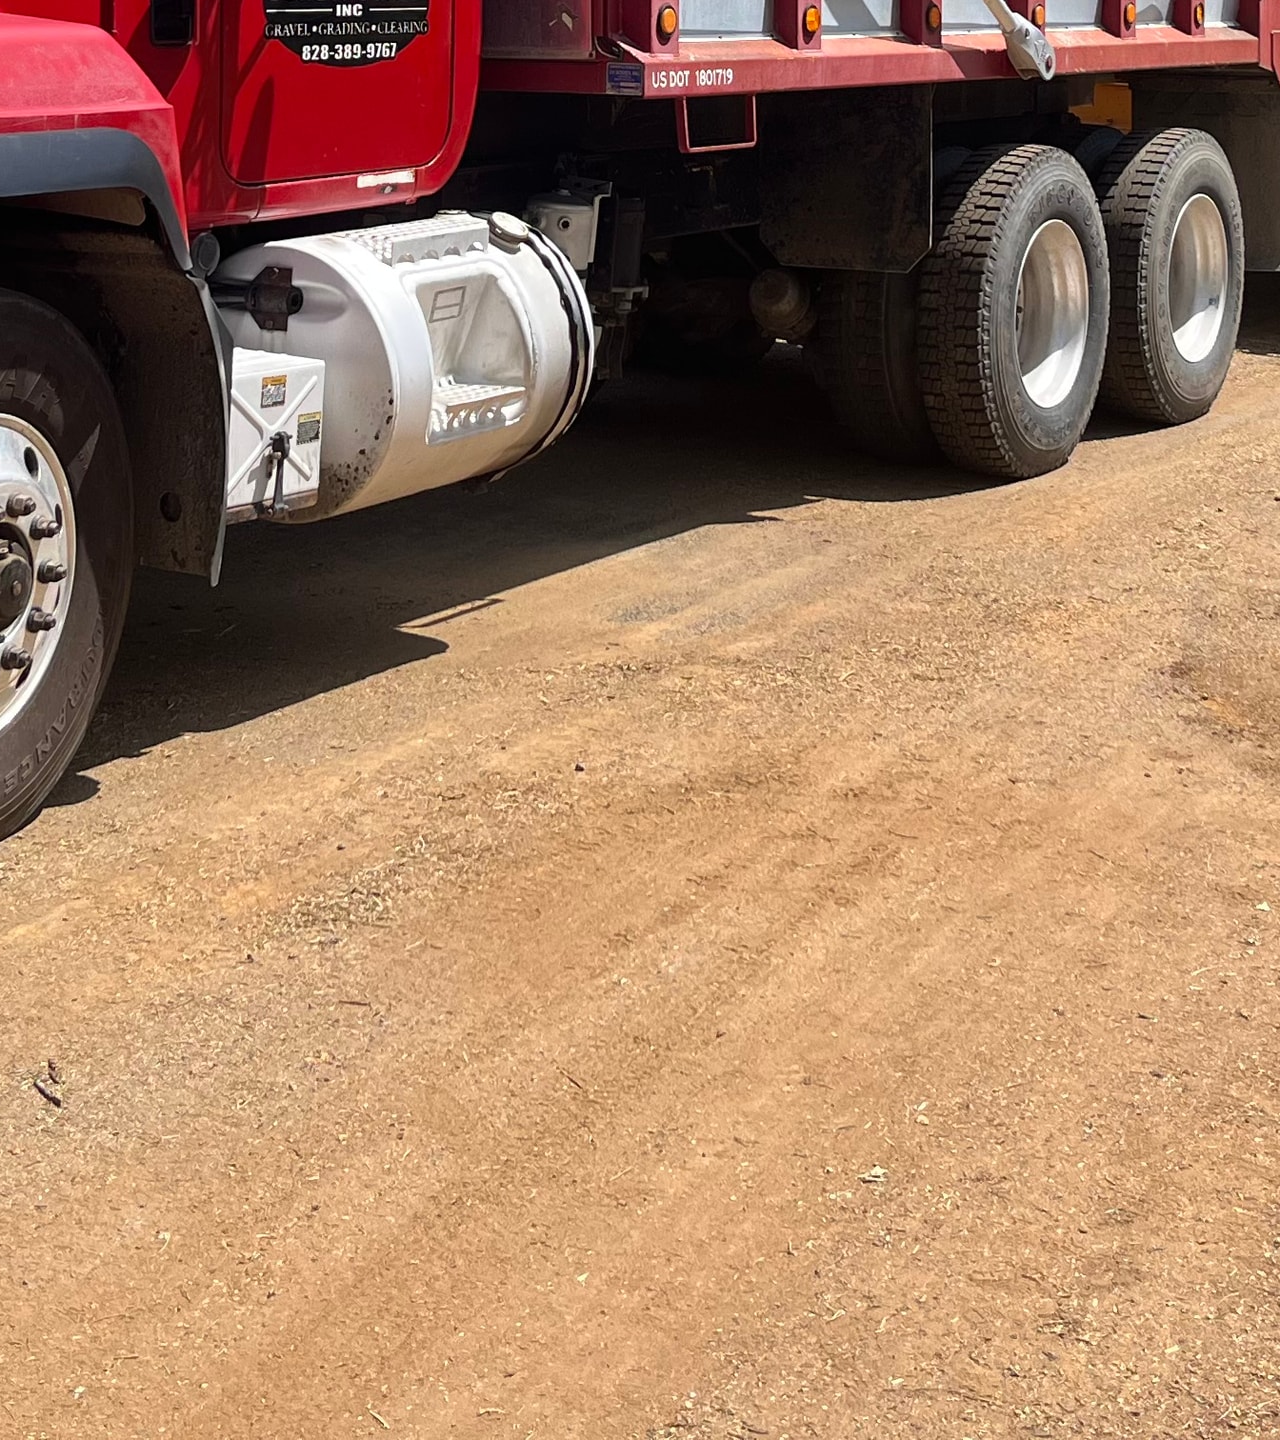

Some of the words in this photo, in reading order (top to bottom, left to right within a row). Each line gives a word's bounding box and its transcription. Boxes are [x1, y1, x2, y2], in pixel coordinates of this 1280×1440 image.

[335, 3, 363, 17] INC
[301, 42, 398, 61] 828-389-9767
[651, 70, 669, 88] US
[669, 70, 691, 87] DOT
[694, 68, 734, 86] 1801719
